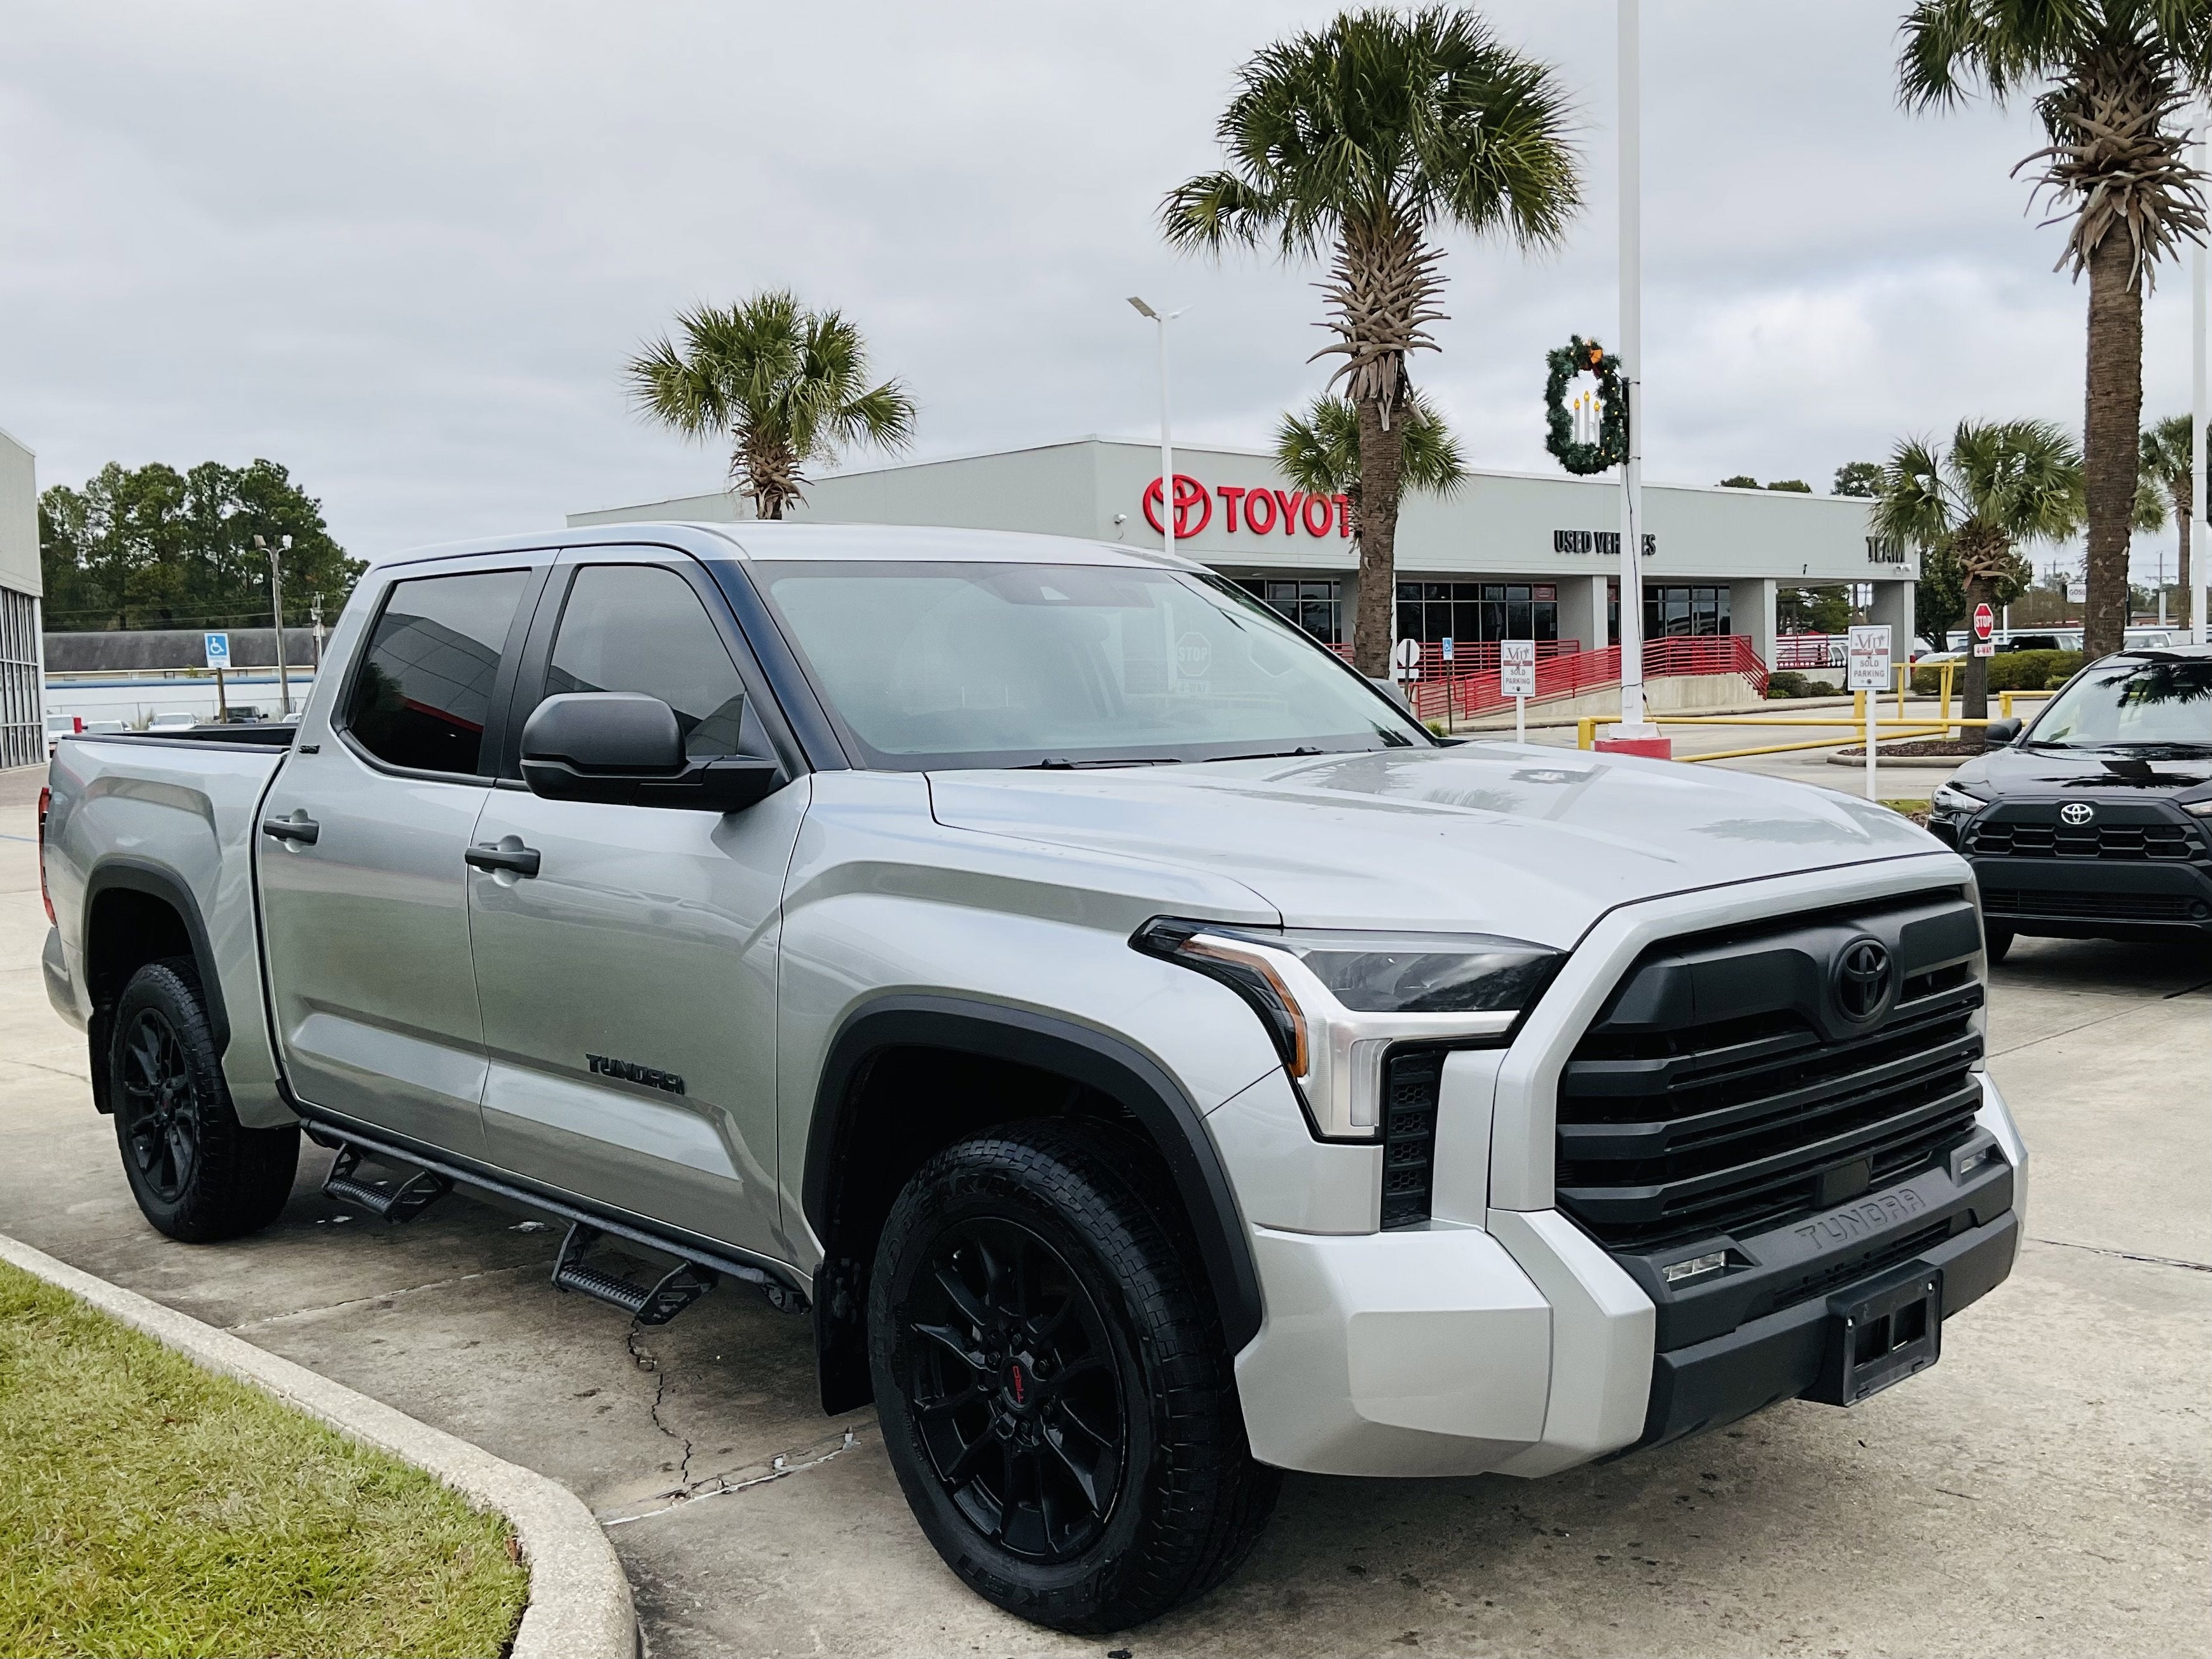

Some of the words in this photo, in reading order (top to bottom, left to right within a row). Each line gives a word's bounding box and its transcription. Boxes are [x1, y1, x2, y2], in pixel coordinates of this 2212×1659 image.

[1217, 485, 1355, 539] TOYOT
[1554, 530, 1592, 553] USED
[1593, 532, 1656, 556] VEHES
[1865, 536, 1905, 563] TEAM
[1975, 615, 1992, 628] STOP
[1179, 647, 1208, 662] STOP
[1977, 646, 1992, 654] 4-WAY
[1179, 682, 1207, 692] 4-WAY
[585, 1052, 685, 1095] TUNDRA
[1794, 1188, 1927, 1249] TUNDRA
